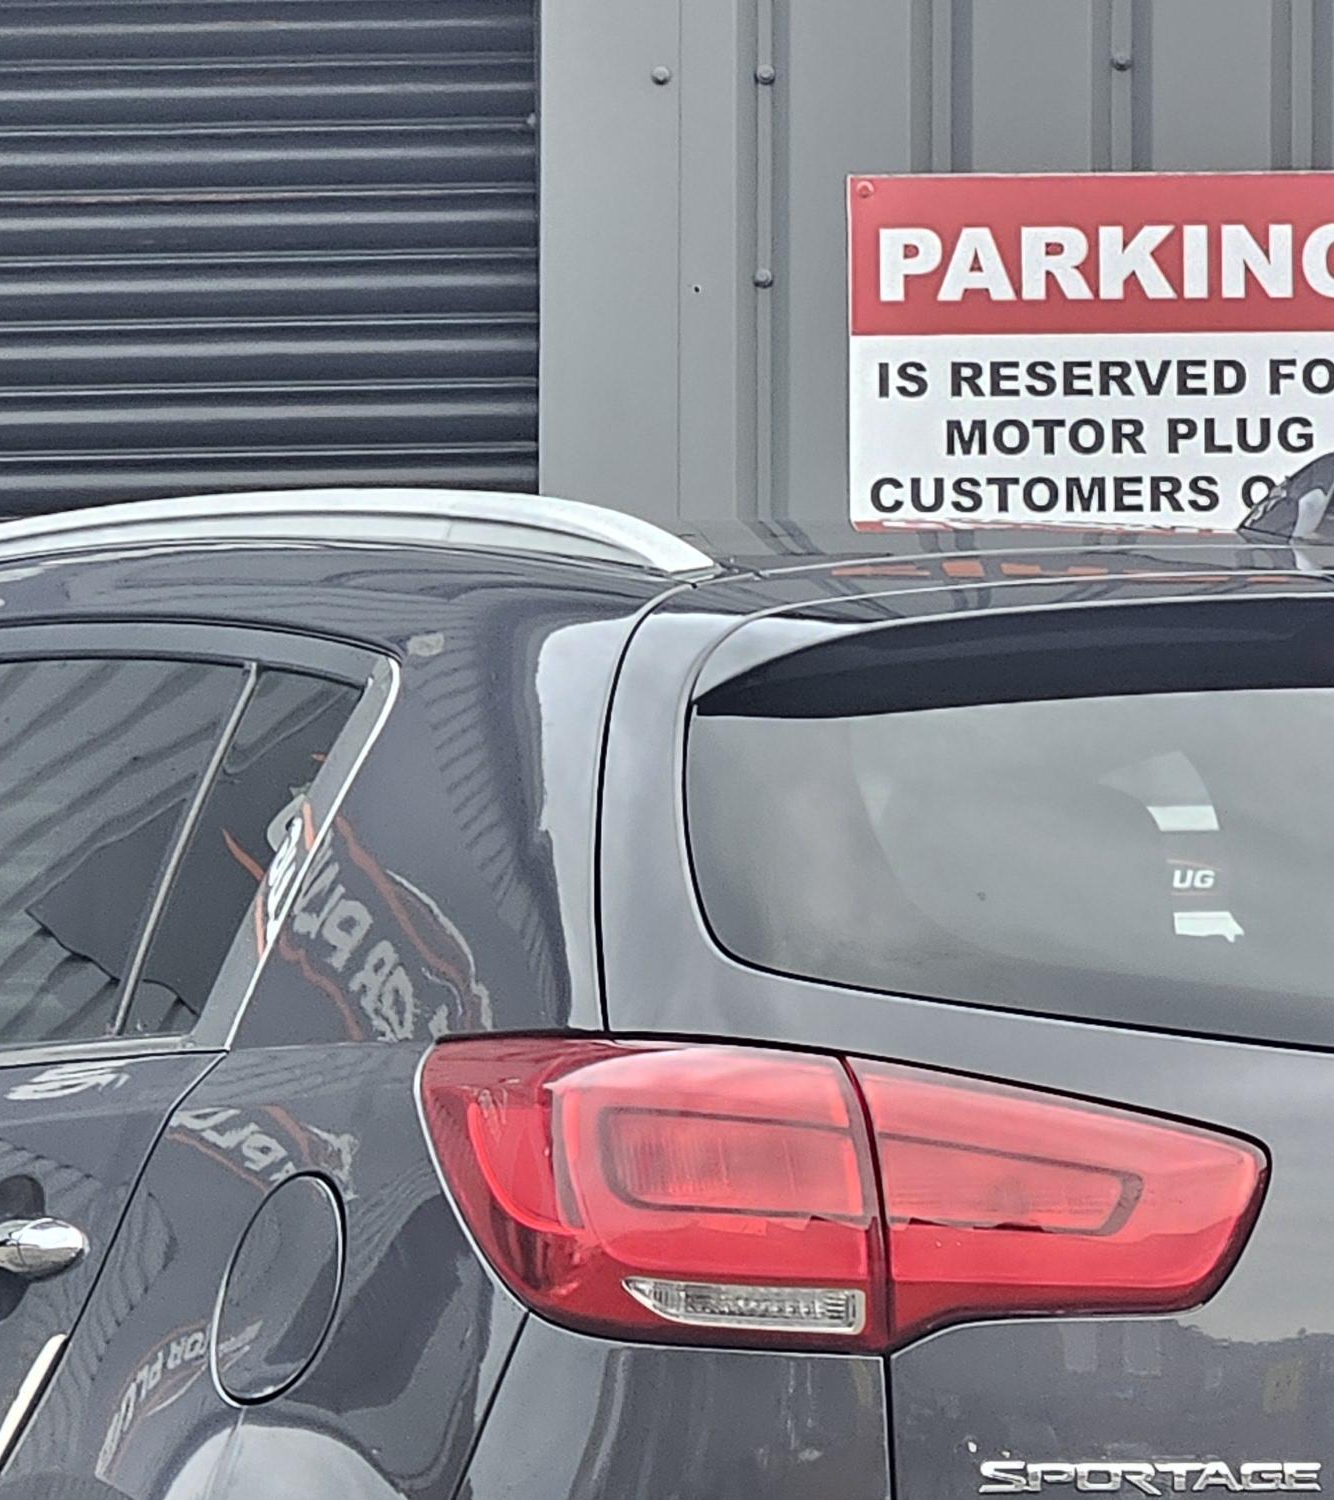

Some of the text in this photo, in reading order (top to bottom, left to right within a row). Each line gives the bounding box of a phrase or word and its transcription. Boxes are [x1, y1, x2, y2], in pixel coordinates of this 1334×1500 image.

[878, 361, 929, 399] IS
[950, 359, 1248, 398] RESERVED
[945, 416, 1315, 456] MOTOR PLUG
[869, 475, 1220, 513] CUSTOMERS
[1172, 869, 1216, 889] UG
[978, 1461, 1322, 1496] SPORTAGE
